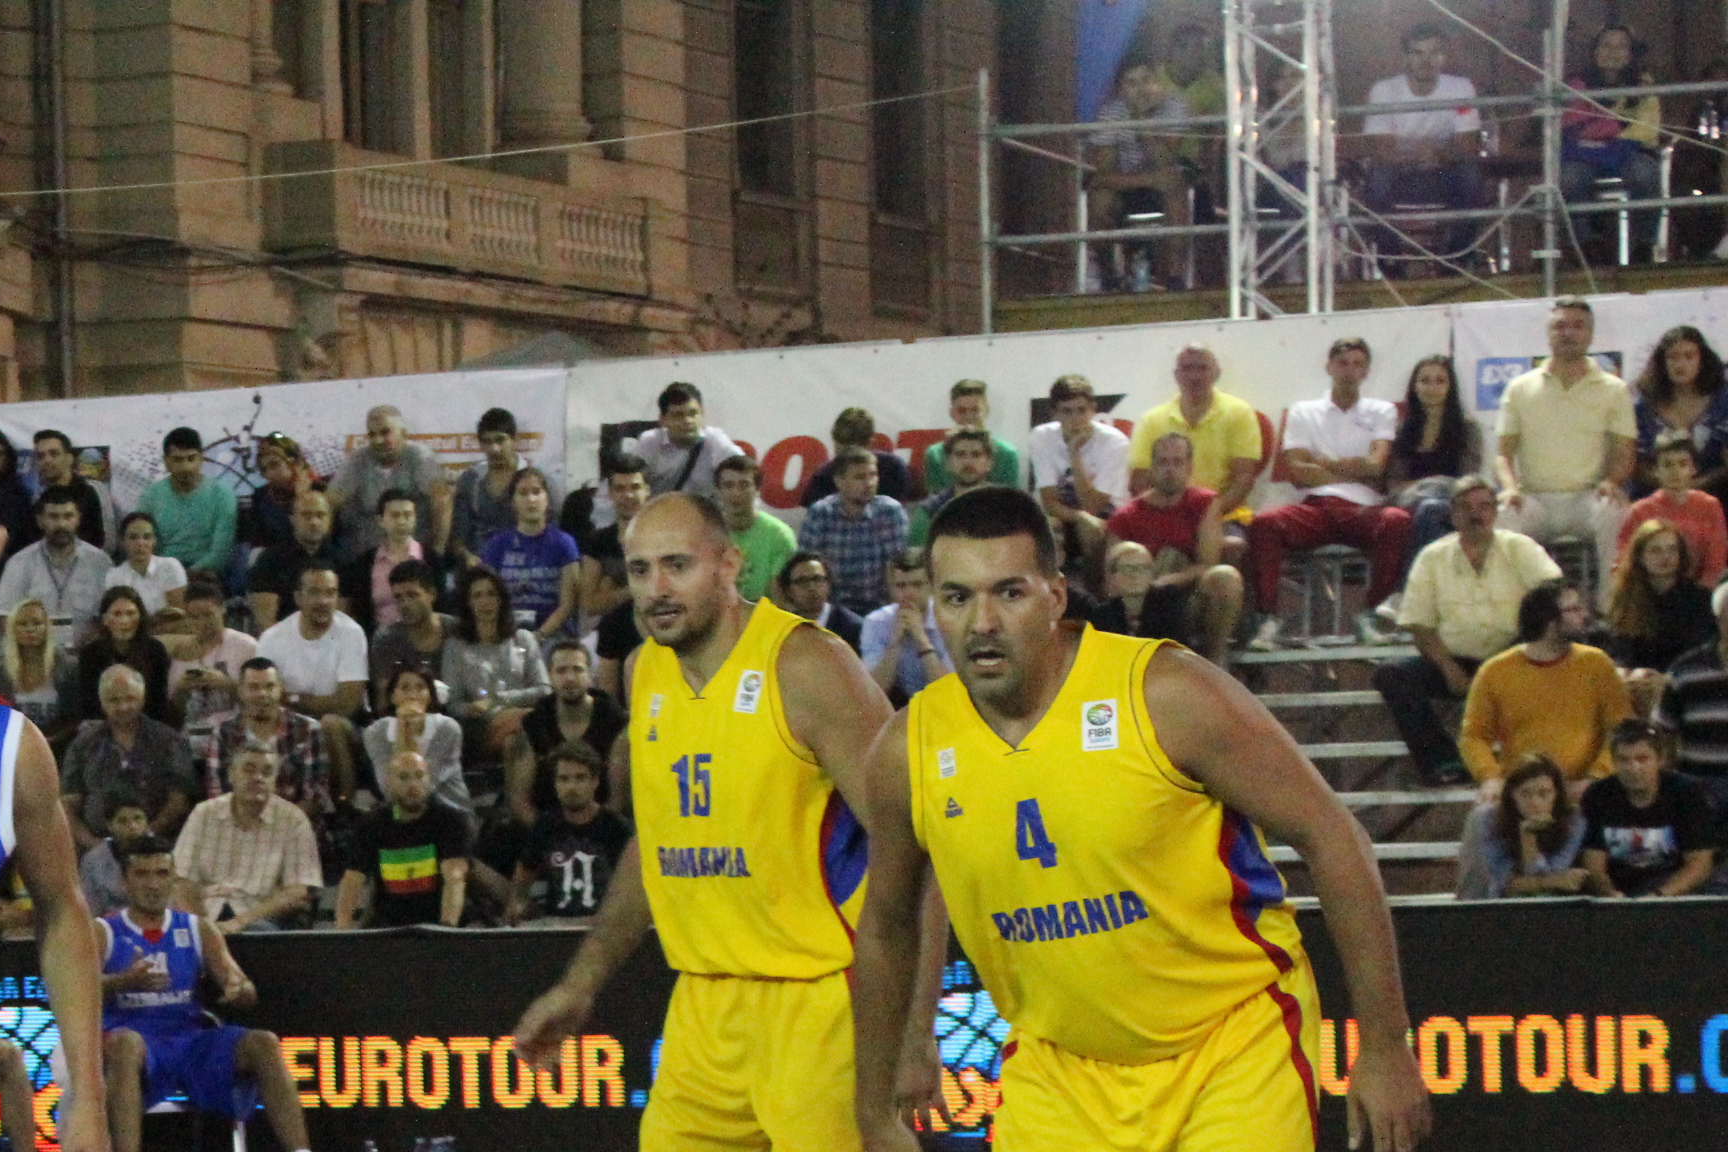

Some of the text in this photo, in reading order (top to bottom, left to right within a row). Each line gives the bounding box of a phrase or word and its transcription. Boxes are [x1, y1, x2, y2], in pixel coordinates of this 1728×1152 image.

[1088, 727, 1112, 739] FIBA
[670, 752, 712, 817] 15
[1015, 798, 1058, 869] 4
[991, 890, 1149, 943] ROMANIA
[279, 1034, 664, 1109] EUROTOUR.
